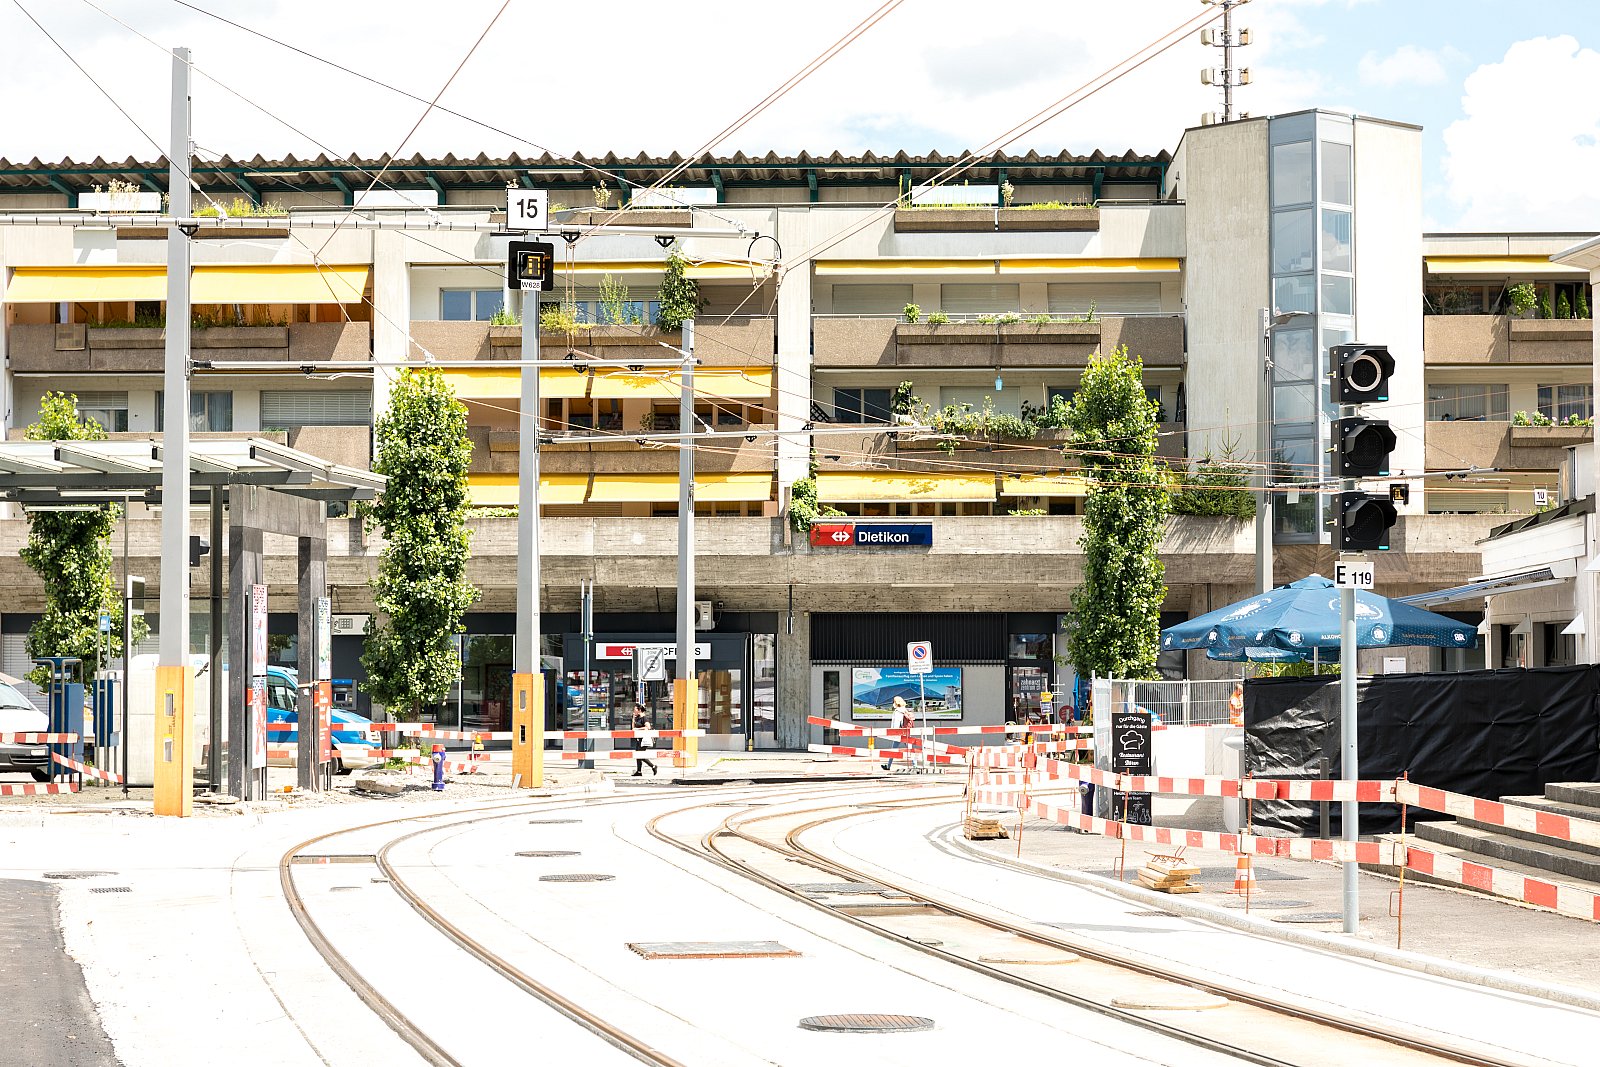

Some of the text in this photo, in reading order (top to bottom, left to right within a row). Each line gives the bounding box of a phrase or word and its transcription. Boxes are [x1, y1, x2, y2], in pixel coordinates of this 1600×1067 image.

[516, 198, 538, 219] 15
[858, 532, 909, 542] Dietikon
[1336, 565, 1372, 585] E 119
[1118, 715, 1146, 724] Durchgang
